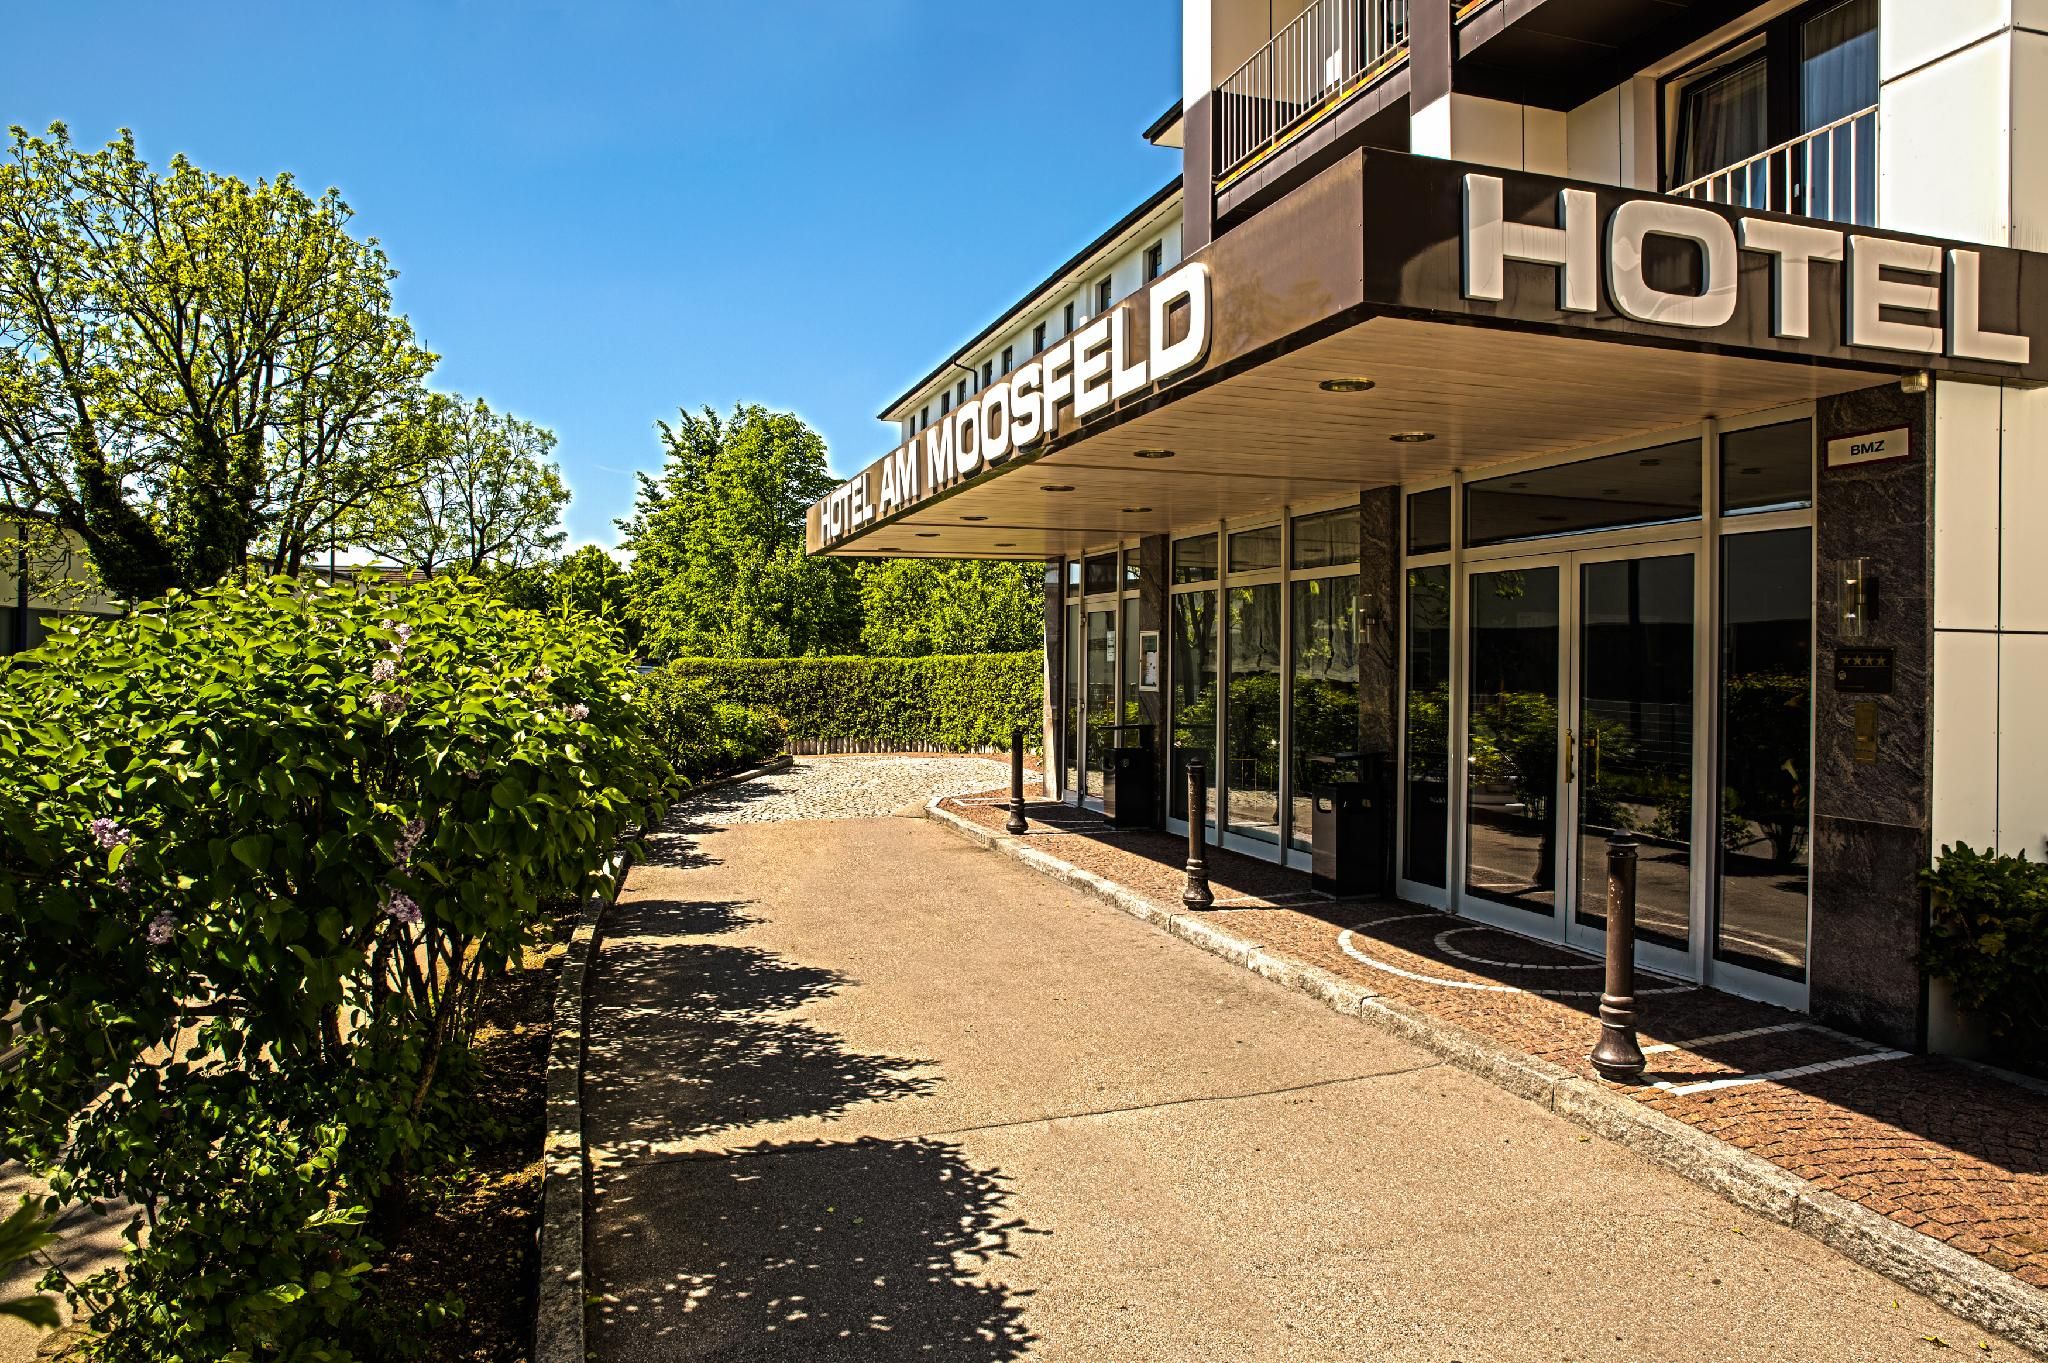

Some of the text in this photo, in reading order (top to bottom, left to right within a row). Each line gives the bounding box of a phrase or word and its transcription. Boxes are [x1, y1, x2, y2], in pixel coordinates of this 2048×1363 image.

[1462, 173, 2030, 365] HOTEL
[821, 262, 1211, 546] HOTEL AM MOOSFELD
[1850, 440, 1885, 456] BMZ
